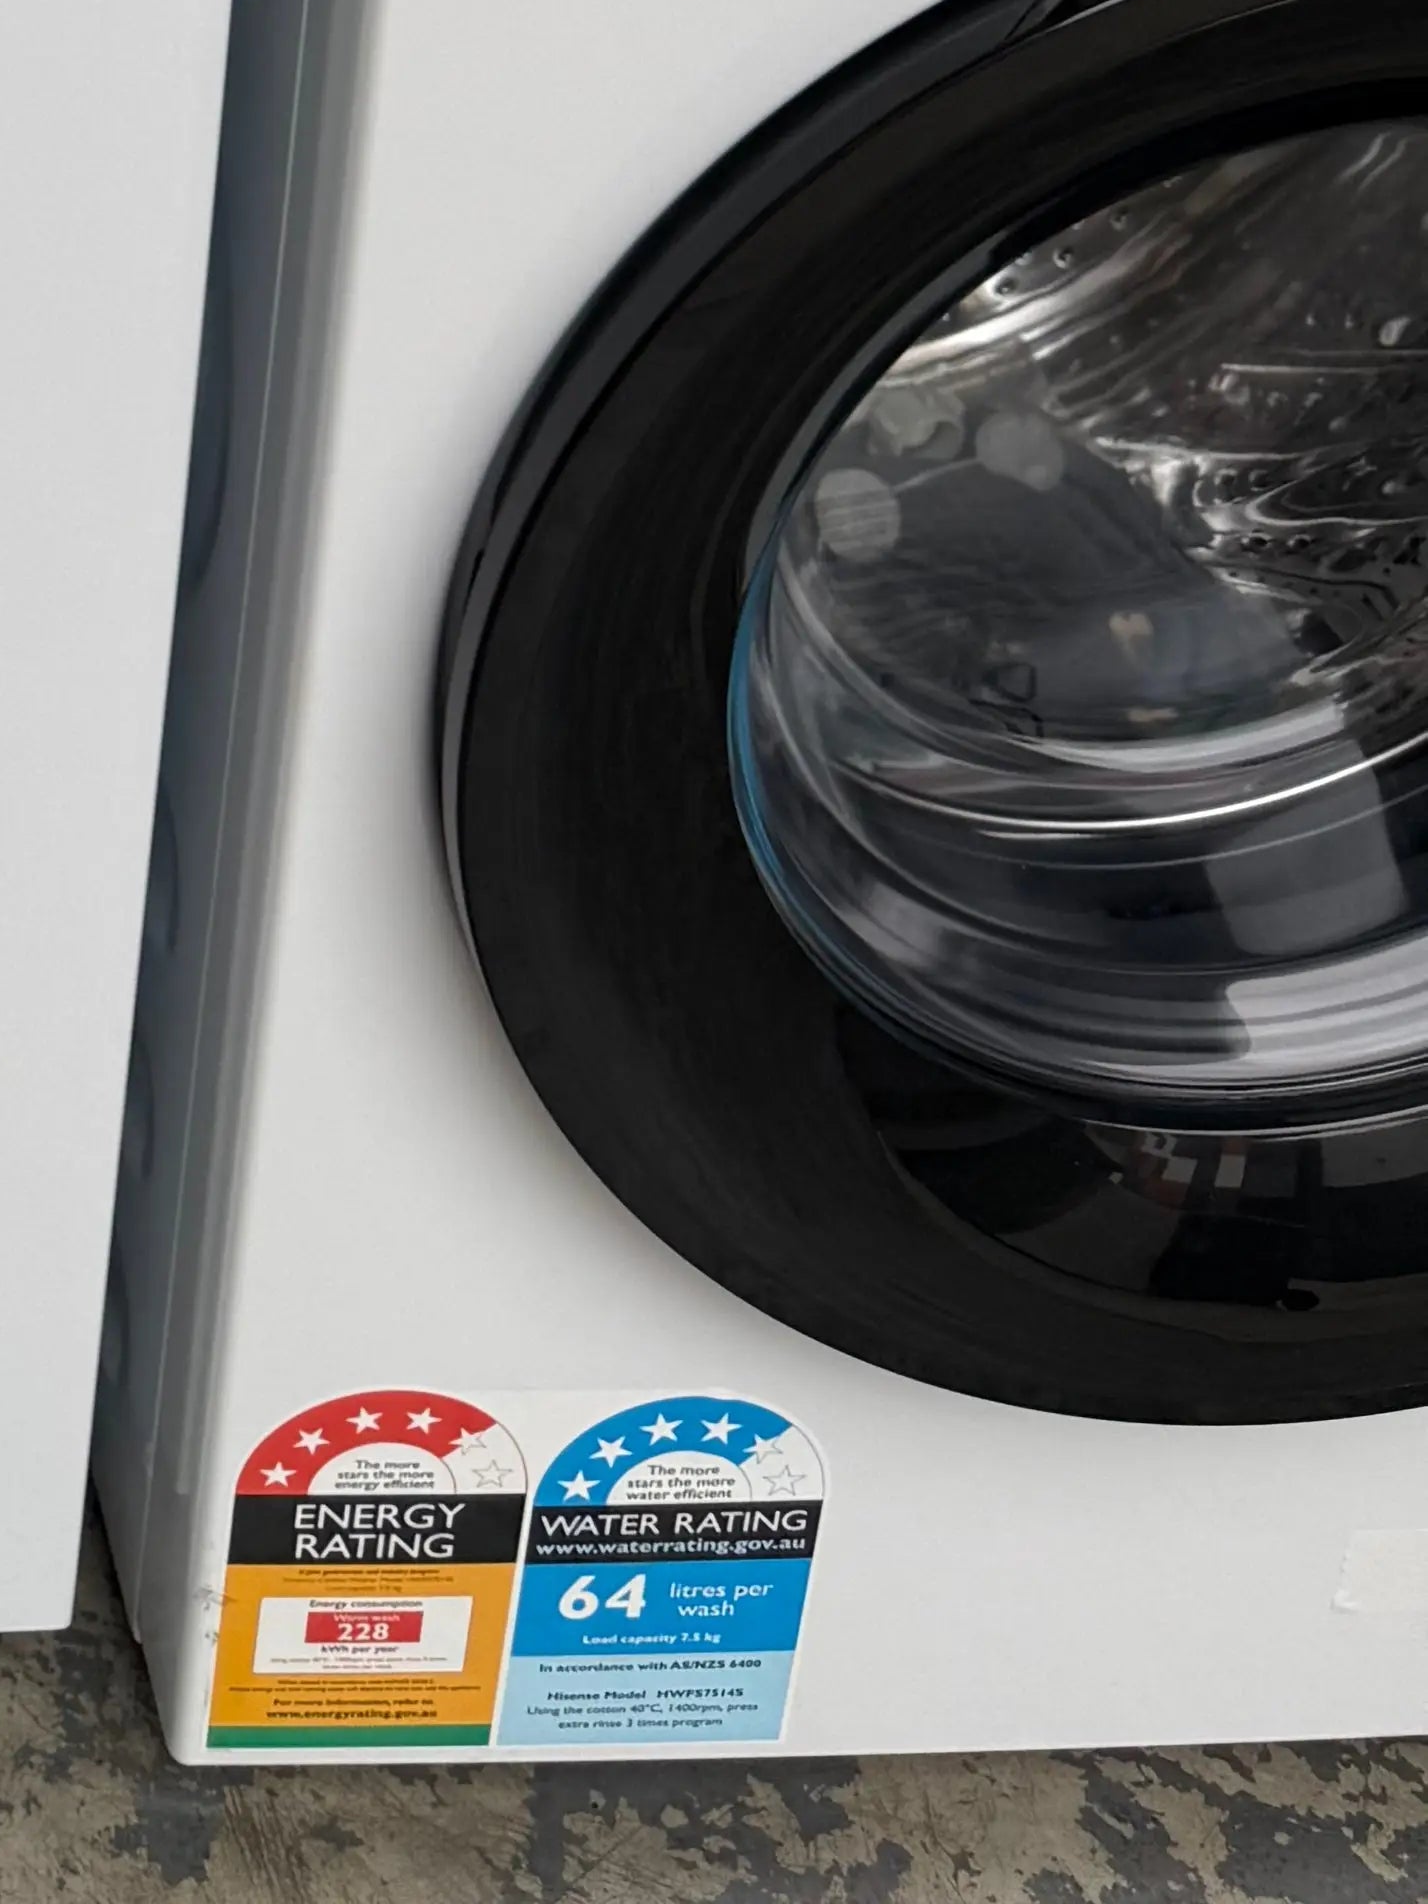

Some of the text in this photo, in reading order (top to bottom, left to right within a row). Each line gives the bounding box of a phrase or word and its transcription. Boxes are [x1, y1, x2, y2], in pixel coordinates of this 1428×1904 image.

[355, 1460, 420, 1470] The more
[648, 1464, 720, 1476] The more
[373, 1470, 396, 1480] the
[399, 1471, 434, 1480] more
[628, 1477, 736, 1489] stars the more
[626, 1489, 732, 1500] water efficient
[294, 1503, 466, 1529] ENERGY
[541, 1510, 808, 1537] WATER RATING
[295, 1533, 455, 1559] RATING
[535, 1538, 806, 1556] www.waterrating.gov.au
[558, 1574, 646, 1620] 64
[670, 1582, 773, 1600] litres per
[678, 1600, 734, 1617] wash
[337, 1623, 390, 1641] 228
[638, 1661, 667, 1670] with
